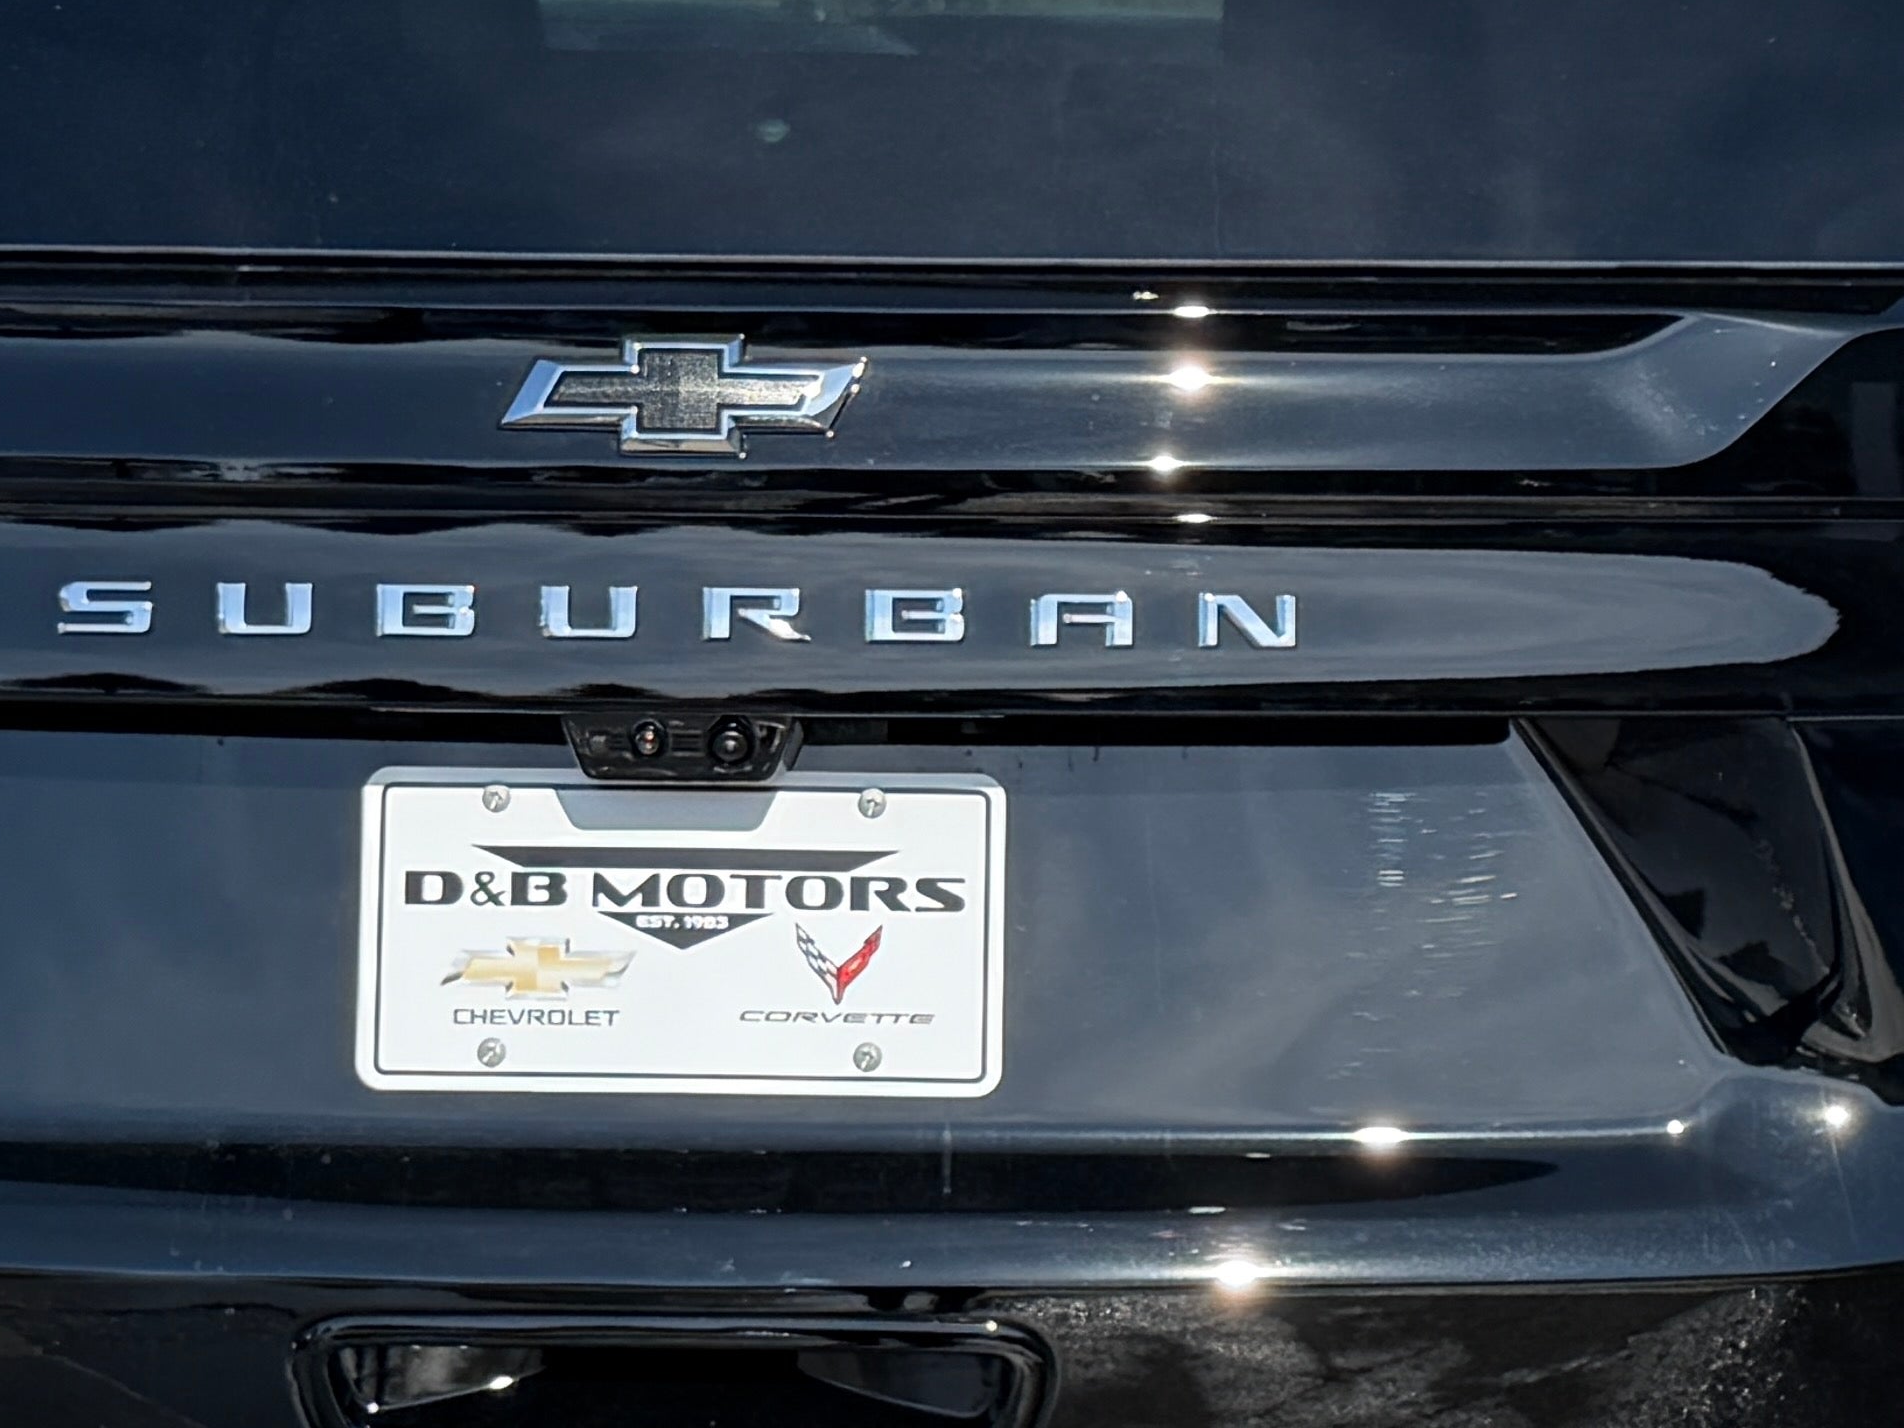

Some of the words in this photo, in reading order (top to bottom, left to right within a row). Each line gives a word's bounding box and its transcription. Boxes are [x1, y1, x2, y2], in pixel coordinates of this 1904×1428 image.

[56, 580, 1299, 650] SUBURBAN
[404, 870, 568, 907] D&B
[592, 871, 967, 914] MOTORS
[452, 1008, 621, 1028] CHEVROLET
[739, 1010, 935, 1026] CORVETTE
